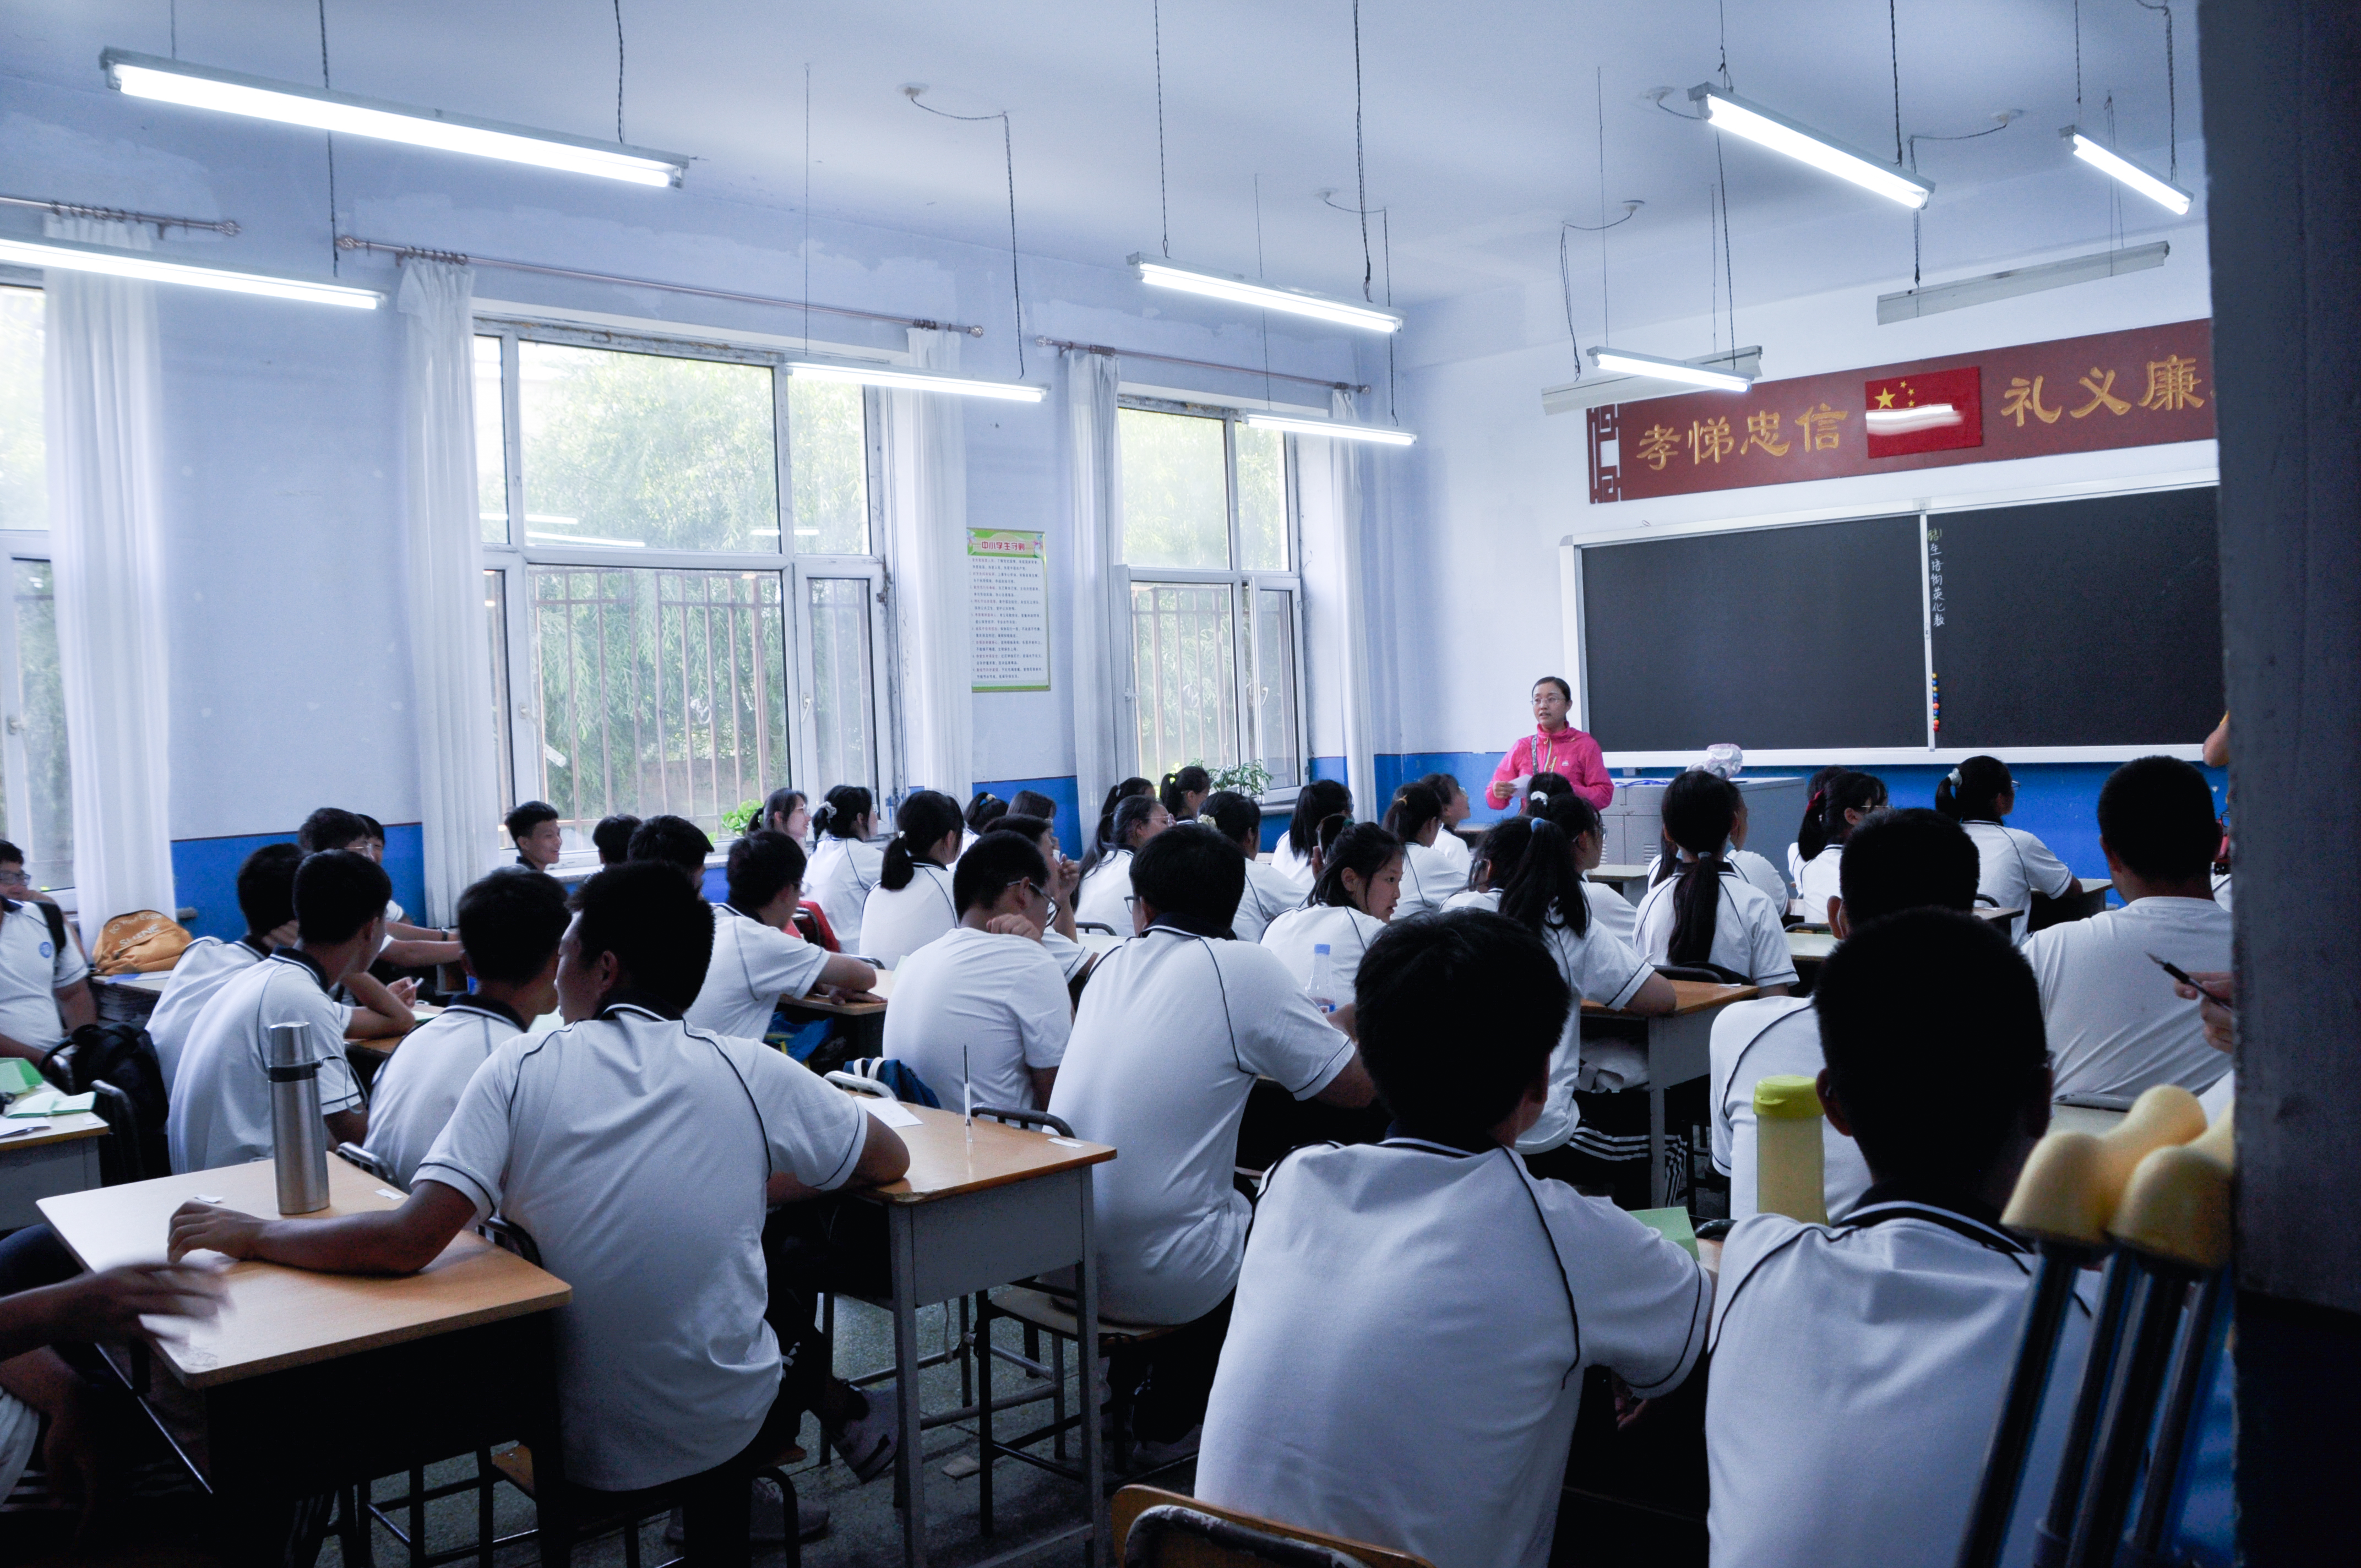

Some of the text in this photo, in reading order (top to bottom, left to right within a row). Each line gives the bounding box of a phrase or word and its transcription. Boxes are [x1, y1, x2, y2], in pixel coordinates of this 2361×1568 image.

[1636, 402, 1848, 470] 孝悌忠信
[981, 541, 1025, 551] 中小学生守则
